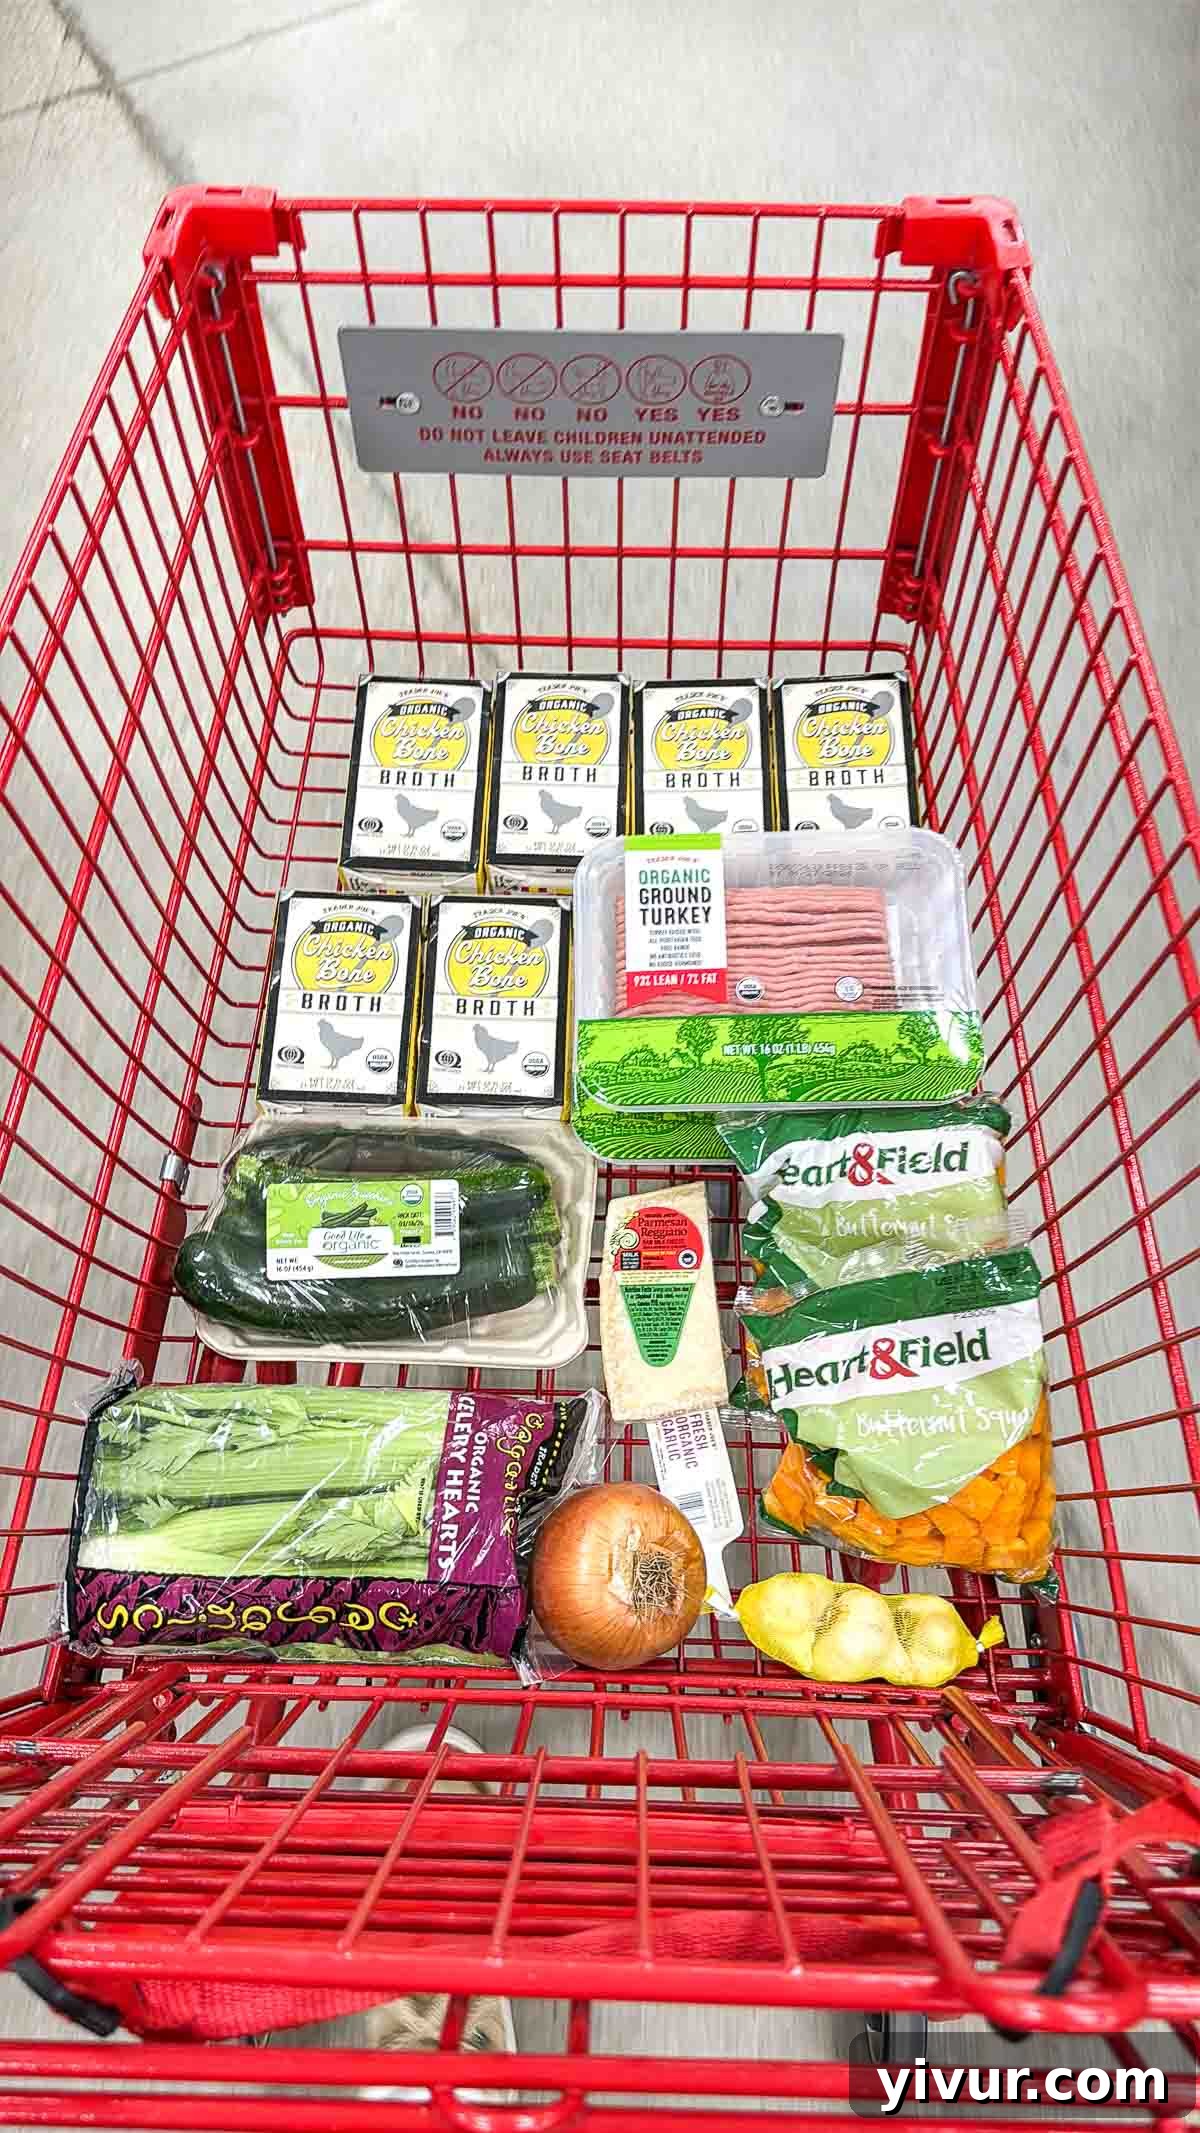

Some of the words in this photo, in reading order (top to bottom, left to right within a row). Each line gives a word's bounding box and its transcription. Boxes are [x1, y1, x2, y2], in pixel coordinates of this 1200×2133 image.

[453, 406, 483, 421] NO
[513, 407, 545, 422] NO
[576, 407, 608, 422] NO
[635, 408, 678, 423] YES
[697, 407, 740, 422] YES
[418, 427, 443, 441] DO
[449, 428, 485, 442] NOT
[492, 429, 546, 444] LEAVE
[553, 430, 642, 445] CHILDREN
[648, 431, 766, 445] UNATTENDED
[483, 449, 553, 463] ALWAYS
[560, 450, 594, 464] USE
[600, 450, 641, 464] SEAT
[649, 450, 703, 464] BELTS
[400, 704, 448, 716] ORGANIC
[539, 700, 588, 712] ORGANIC
[678, 709, 725, 720] ORGANIC
[818, 702, 868, 713] ORGANIC
[380, 717, 464, 741] Chicken
[521, 712, 604, 736] Chicken
[661, 721, 744, 741] Chicken
[802, 716, 887, 737] Chicken
[393, 738, 449, 761] Bone
[536, 734, 590, 755] Bone
[677, 740, 732, 762] Bone
[819, 735, 873, 759] Bone
[380, 769, 455, 788] BROTH
[523, 766, 597, 783] BROTH
[666, 772, 740, 788] BROTH
[809, 769, 884, 786] BROTH
[639, 869, 711, 885] ORGANIC
[639, 886, 712, 905] GROUND
[640, 906, 712, 926] TURKEY
[324, 922, 374, 935] ORGANIC
[474, 927, 525, 941] ORGANIC
[303, 934, 392, 961] Chicken
[455, 941, 543, 966] Chicken
[316, 958, 376, 983] Bone
[471, 965, 528, 988] Bone
[653, 974, 678, 986] LEAN
[701, 973, 718, 984] FAT
[301, 993, 381, 1012] BROTH
[456, 999, 534, 1016] BROTH
[723, 1044, 740, 1056] NET
[760, 1043, 771, 1055] 16
[772, 1043, 784, 1054] OZ
[779, 1141, 969, 1187] eart&Field
[638, 1218, 688, 1227] Parmesan
[324, 1231, 346, 1240] Good
[348, 1230, 365, 1240] Life
[641, 1227, 688, 1240] Reggiano
[322, 1239, 380, 1253] organic
[766, 1327, 992, 1399] Heart&Field
[449, 1396, 476, 1465] CELERY
[689, 1413, 709, 1450] FRESH
[661, 1419, 682, 1462] GARLIC
[675, 1416, 699, 1470] ORGANIC
[465, 1431, 487, 1514] ORGANIC
[530, 1446, 548, 1488] TRADER
[437, 1469, 460, 1570] HEARTS
